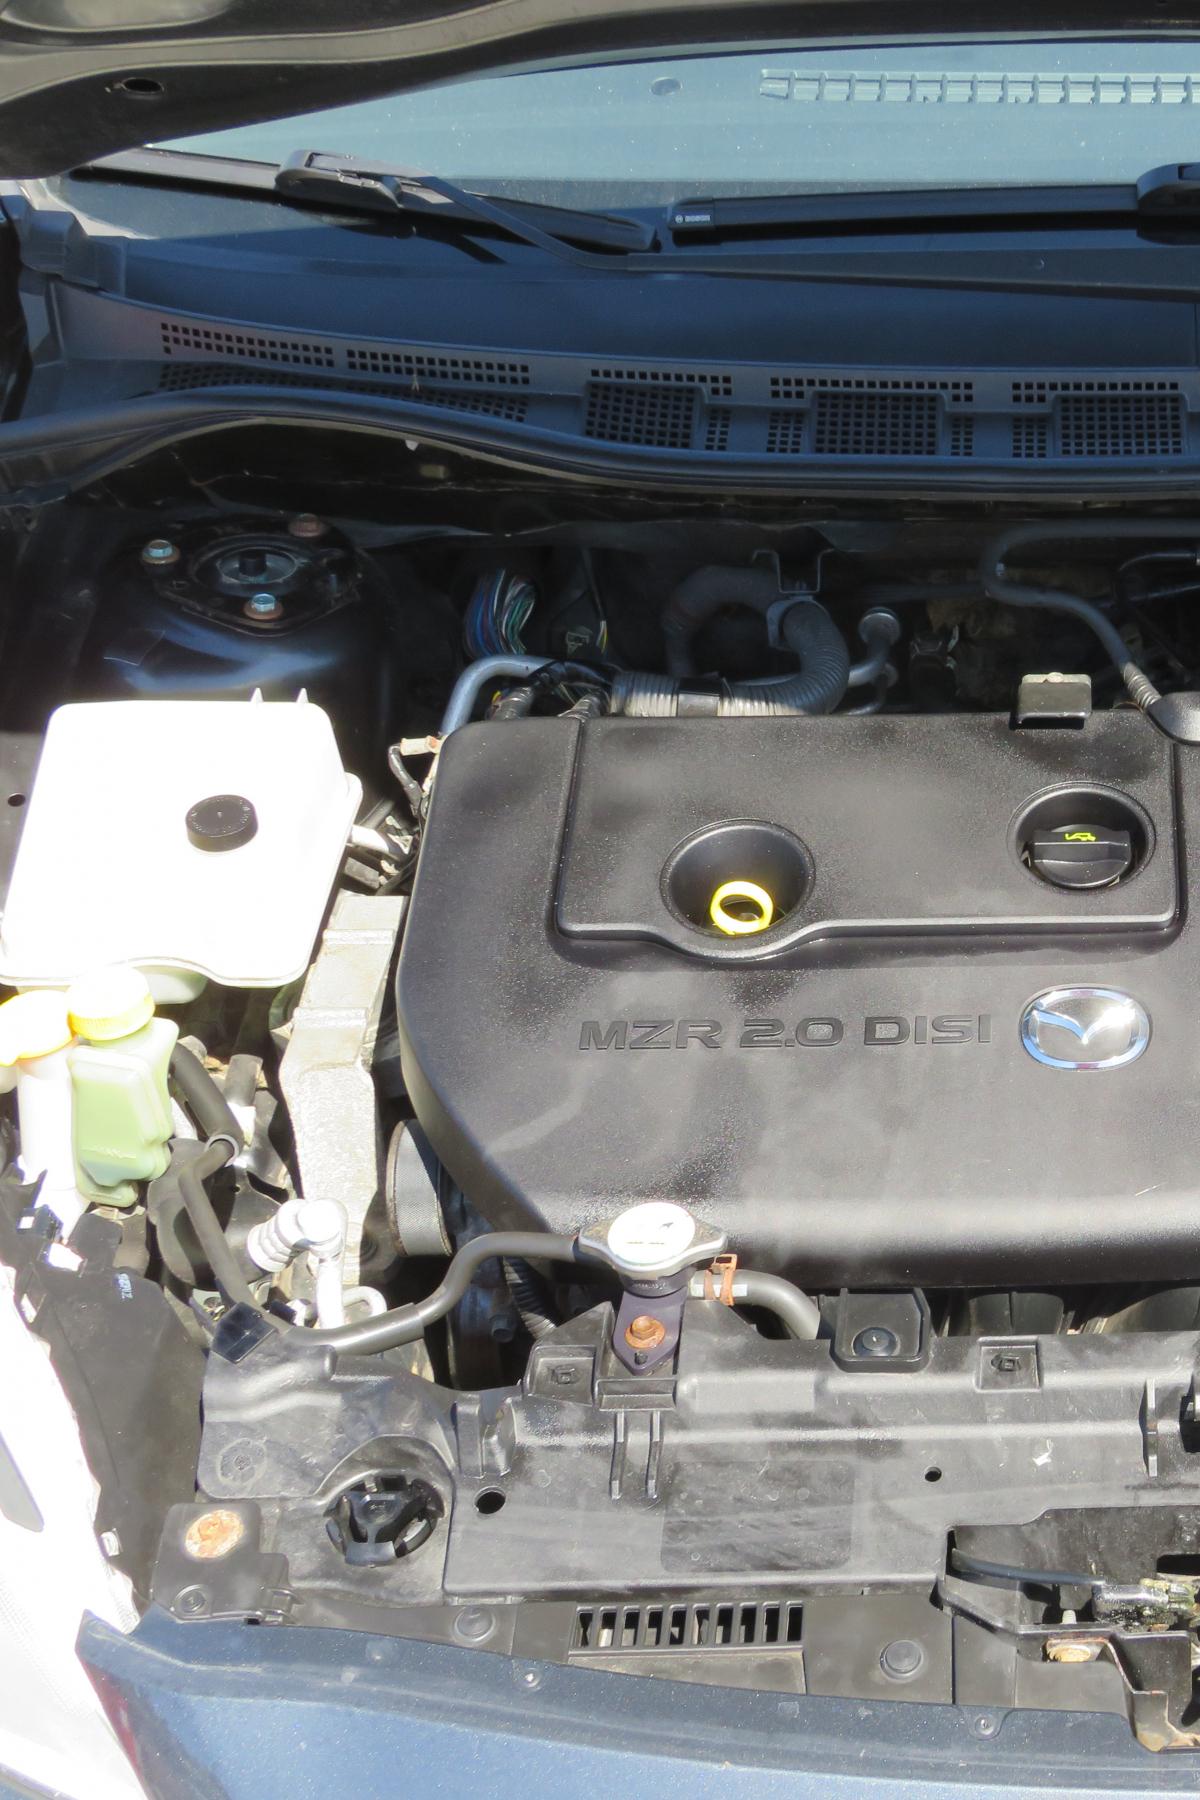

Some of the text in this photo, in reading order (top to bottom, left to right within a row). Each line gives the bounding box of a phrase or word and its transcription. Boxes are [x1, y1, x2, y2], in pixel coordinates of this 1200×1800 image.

[579, 1014, 992, 1050] MZR 2.0 DISI
